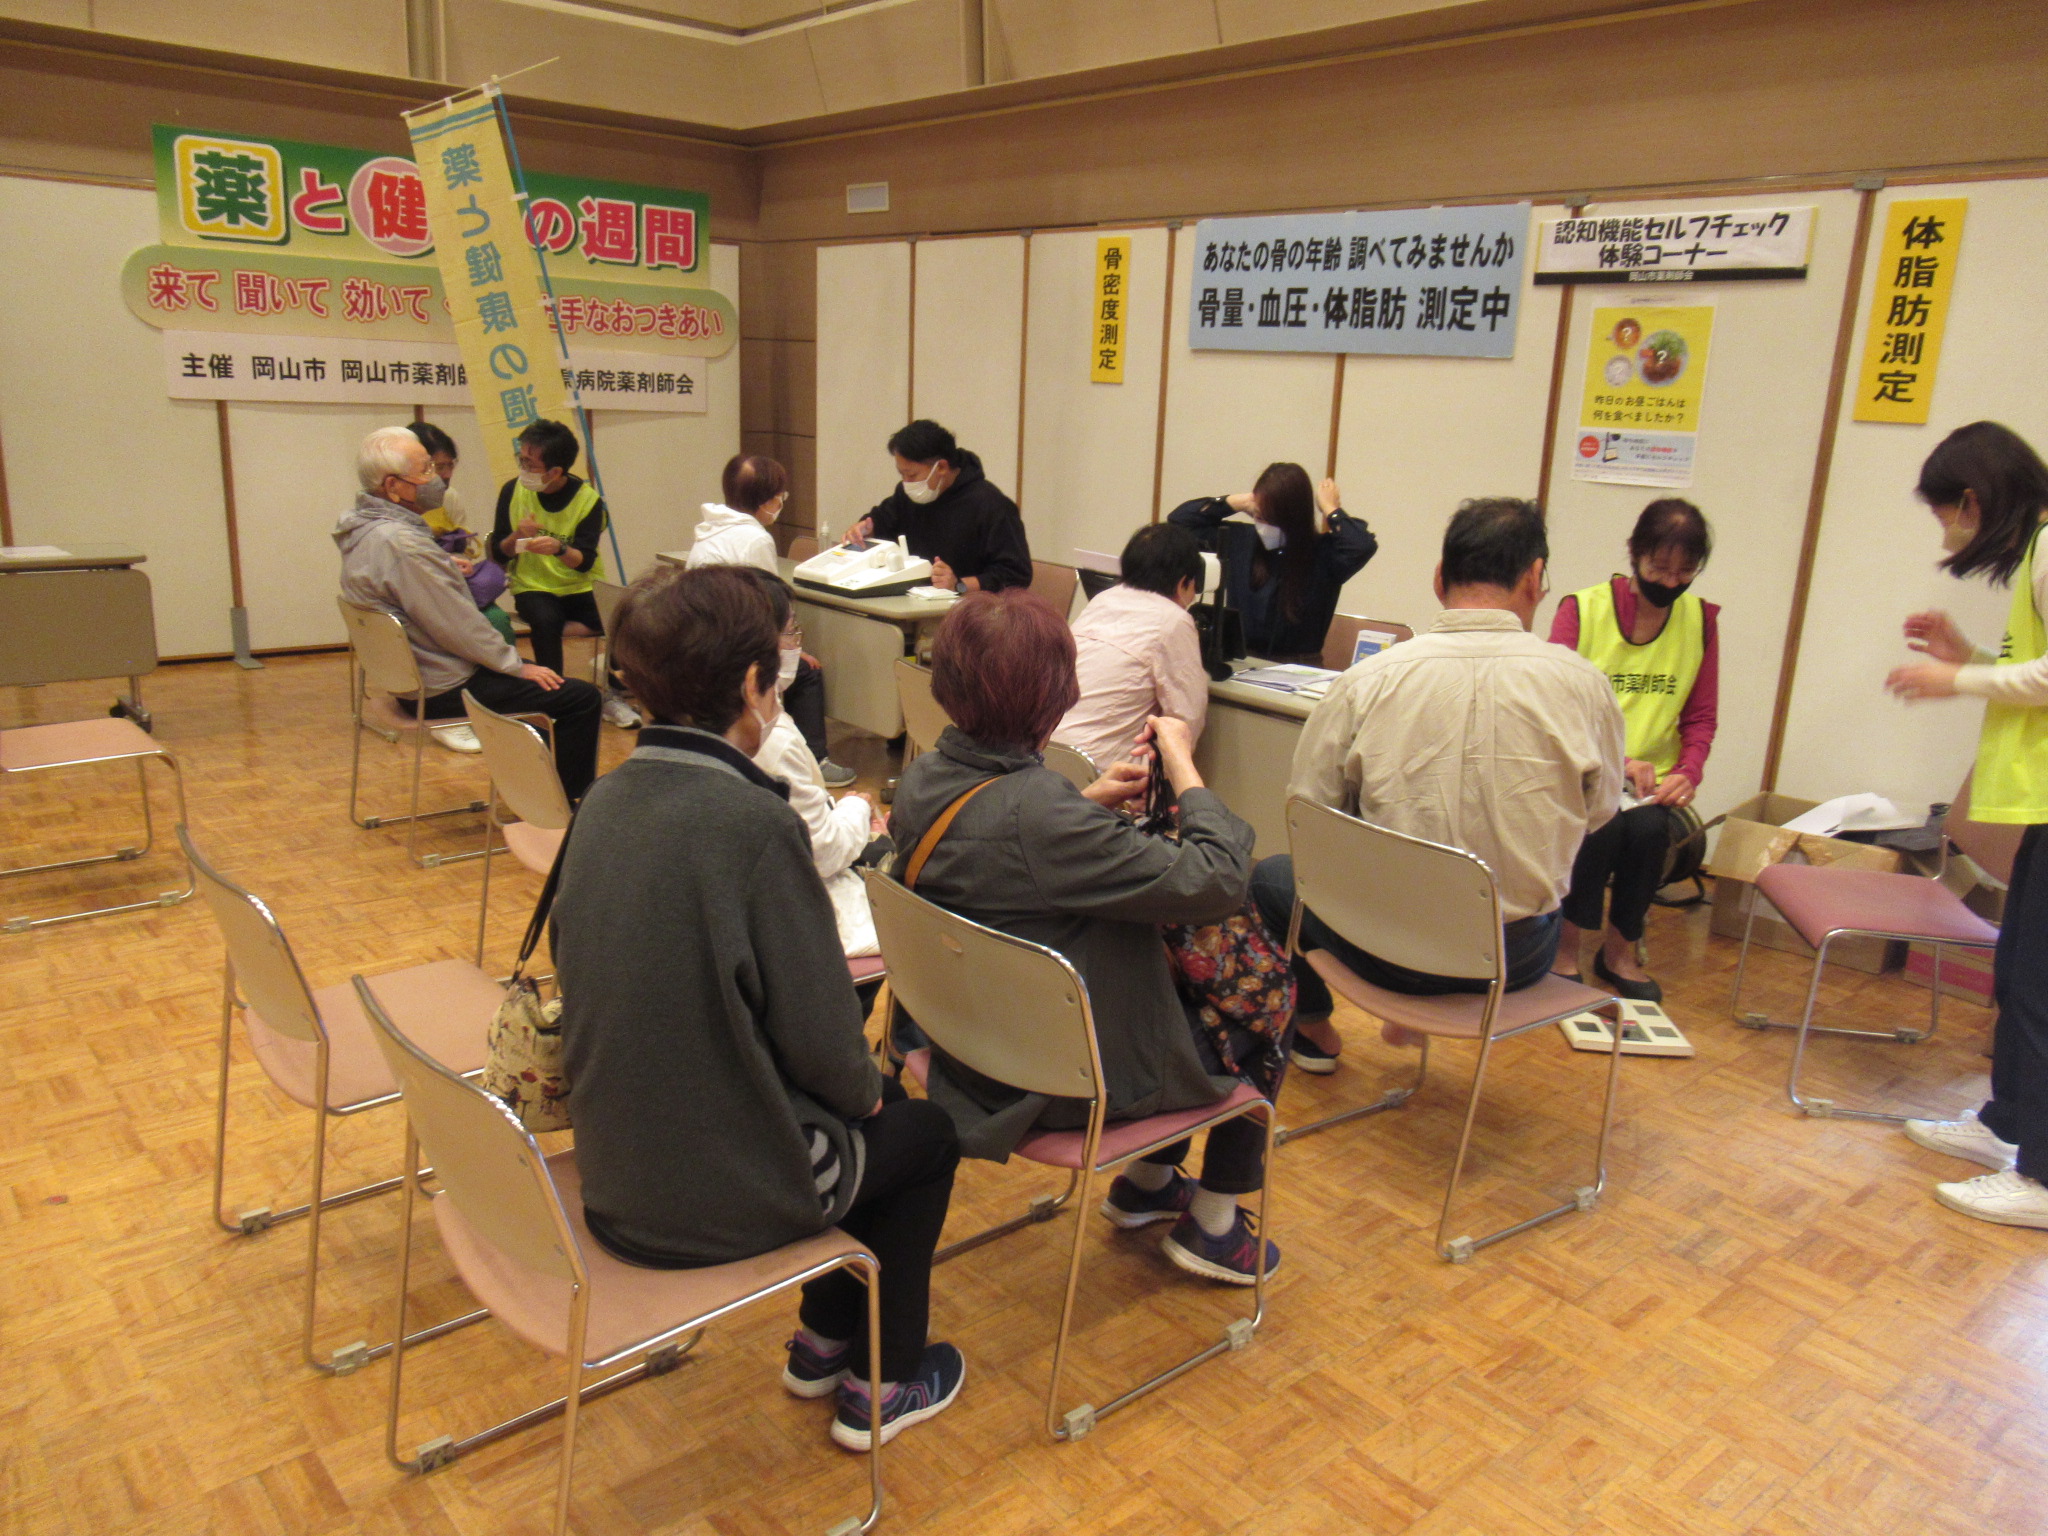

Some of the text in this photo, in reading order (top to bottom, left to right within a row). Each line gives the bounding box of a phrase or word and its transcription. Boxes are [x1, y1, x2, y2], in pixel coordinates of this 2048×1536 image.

[192, 150, 695, 267] 薬と健の週間
[1554, 213, 1791, 244] 認知機能セルフチェック
[1203, 232, 1515, 272] あなたの骨の年齢 調べてみませんか
[1599, 242, 1728, 268] 体験コーナー
[151, 265, 217, 311] 来て
[235, 272, 328, 316] 聞いて
[345, 280, 430, 321] 効いて
[1098, 247, 1122, 370] 骨密度測定
[1198, 285, 1510, 332] 骨量・血圧・体脂肪 測定中
[1874, 215, 1945, 403] 体脂肪測定
[182, 353, 234, 379] 主催
[252, 356, 326, 382] 岡山市
[561, 368, 694, 395] 病院薬剤師会
